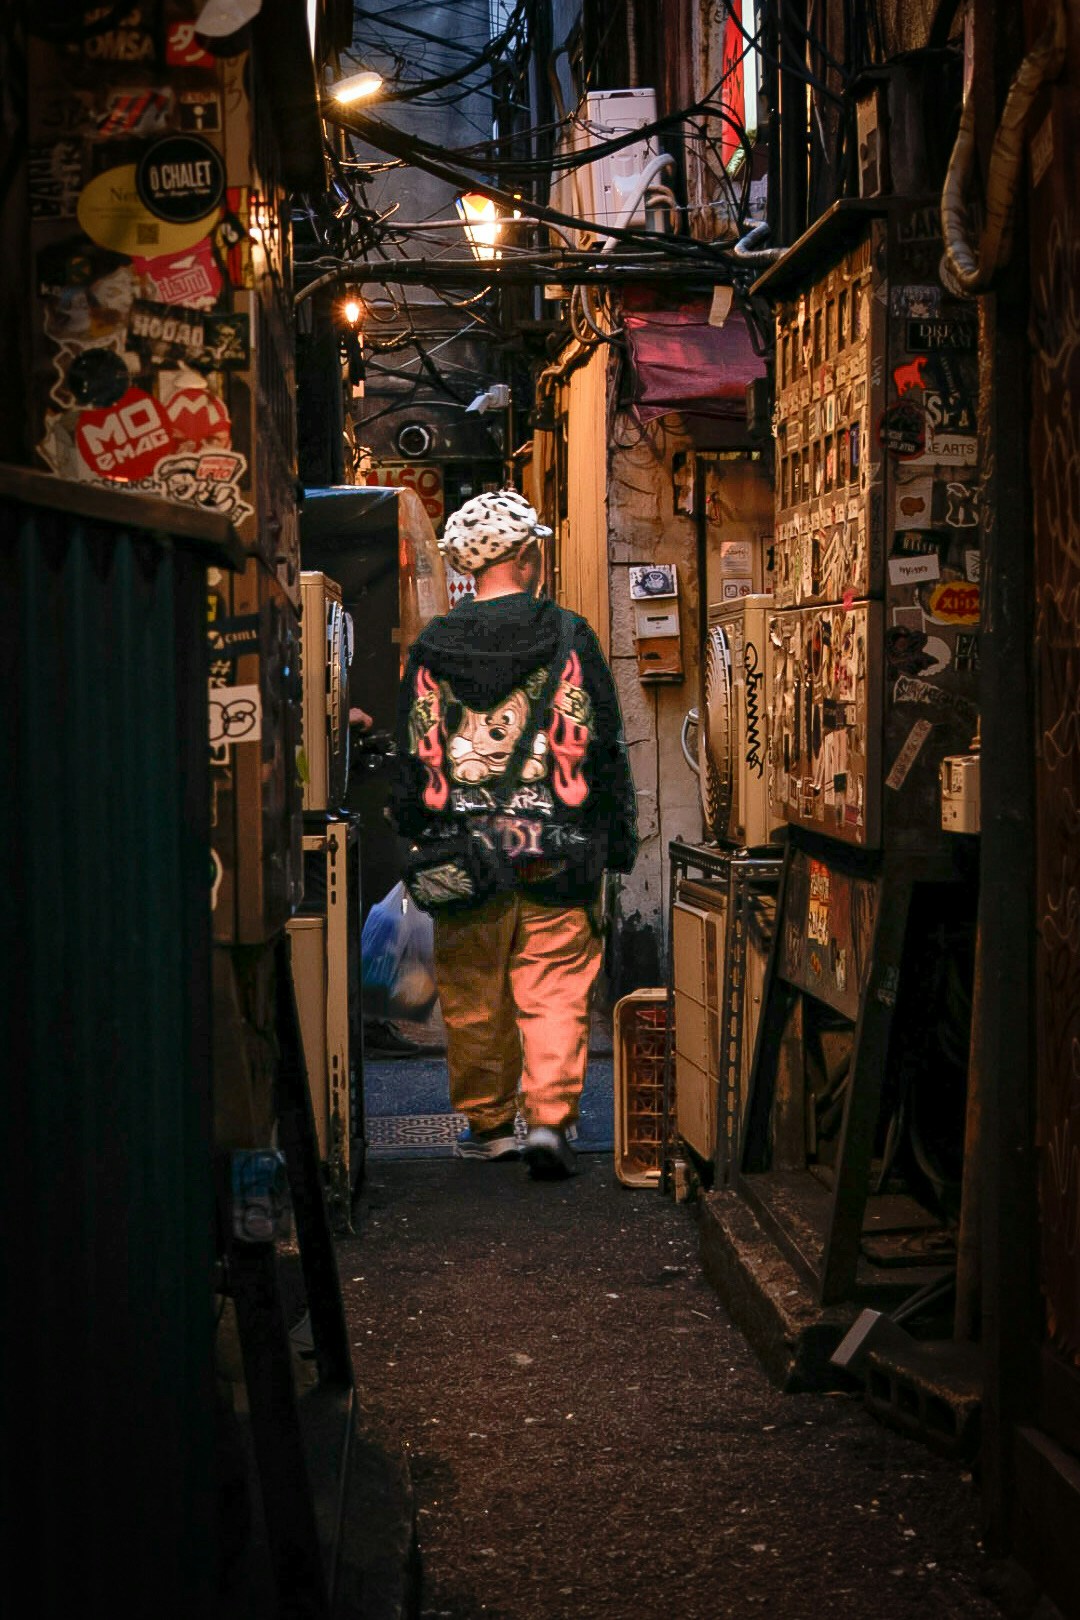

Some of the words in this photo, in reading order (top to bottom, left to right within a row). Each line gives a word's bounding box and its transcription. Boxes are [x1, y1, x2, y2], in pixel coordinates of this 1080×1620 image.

[161, 161, 211, 190] CHALET
[81, 398, 162, 456] MO
[942, 443, 975, 455] ARTS
